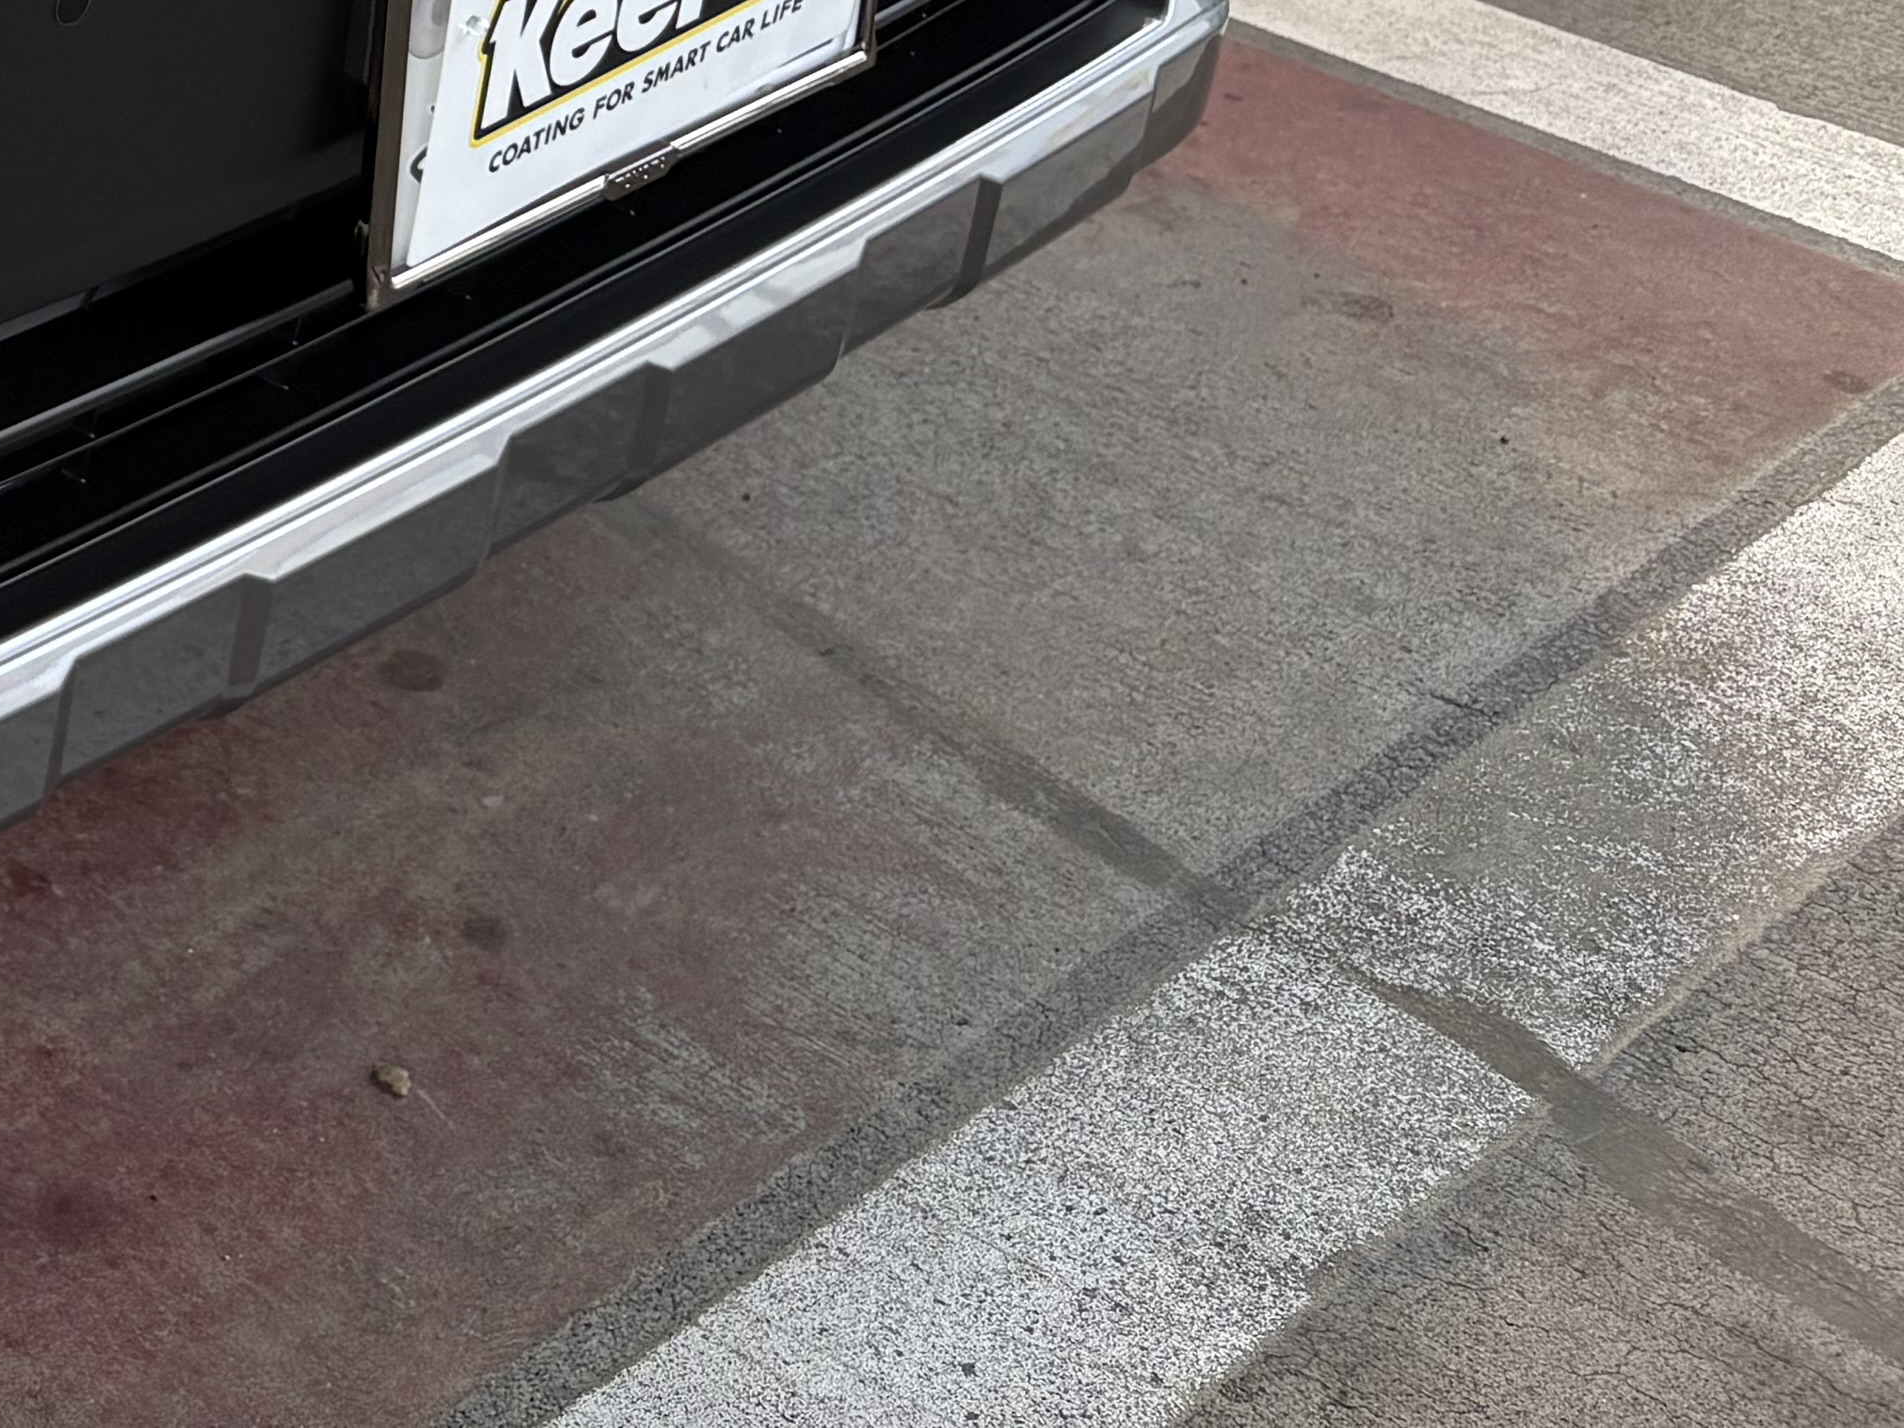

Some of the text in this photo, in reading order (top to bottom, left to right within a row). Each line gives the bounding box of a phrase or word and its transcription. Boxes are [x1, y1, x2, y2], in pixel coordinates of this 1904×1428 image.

[488, 107, 585, 174] COATING
[592, 81, 635, 120] FOR
[641, 42, 710, 94] SMART
[715, 16, 755, 54] CAR
